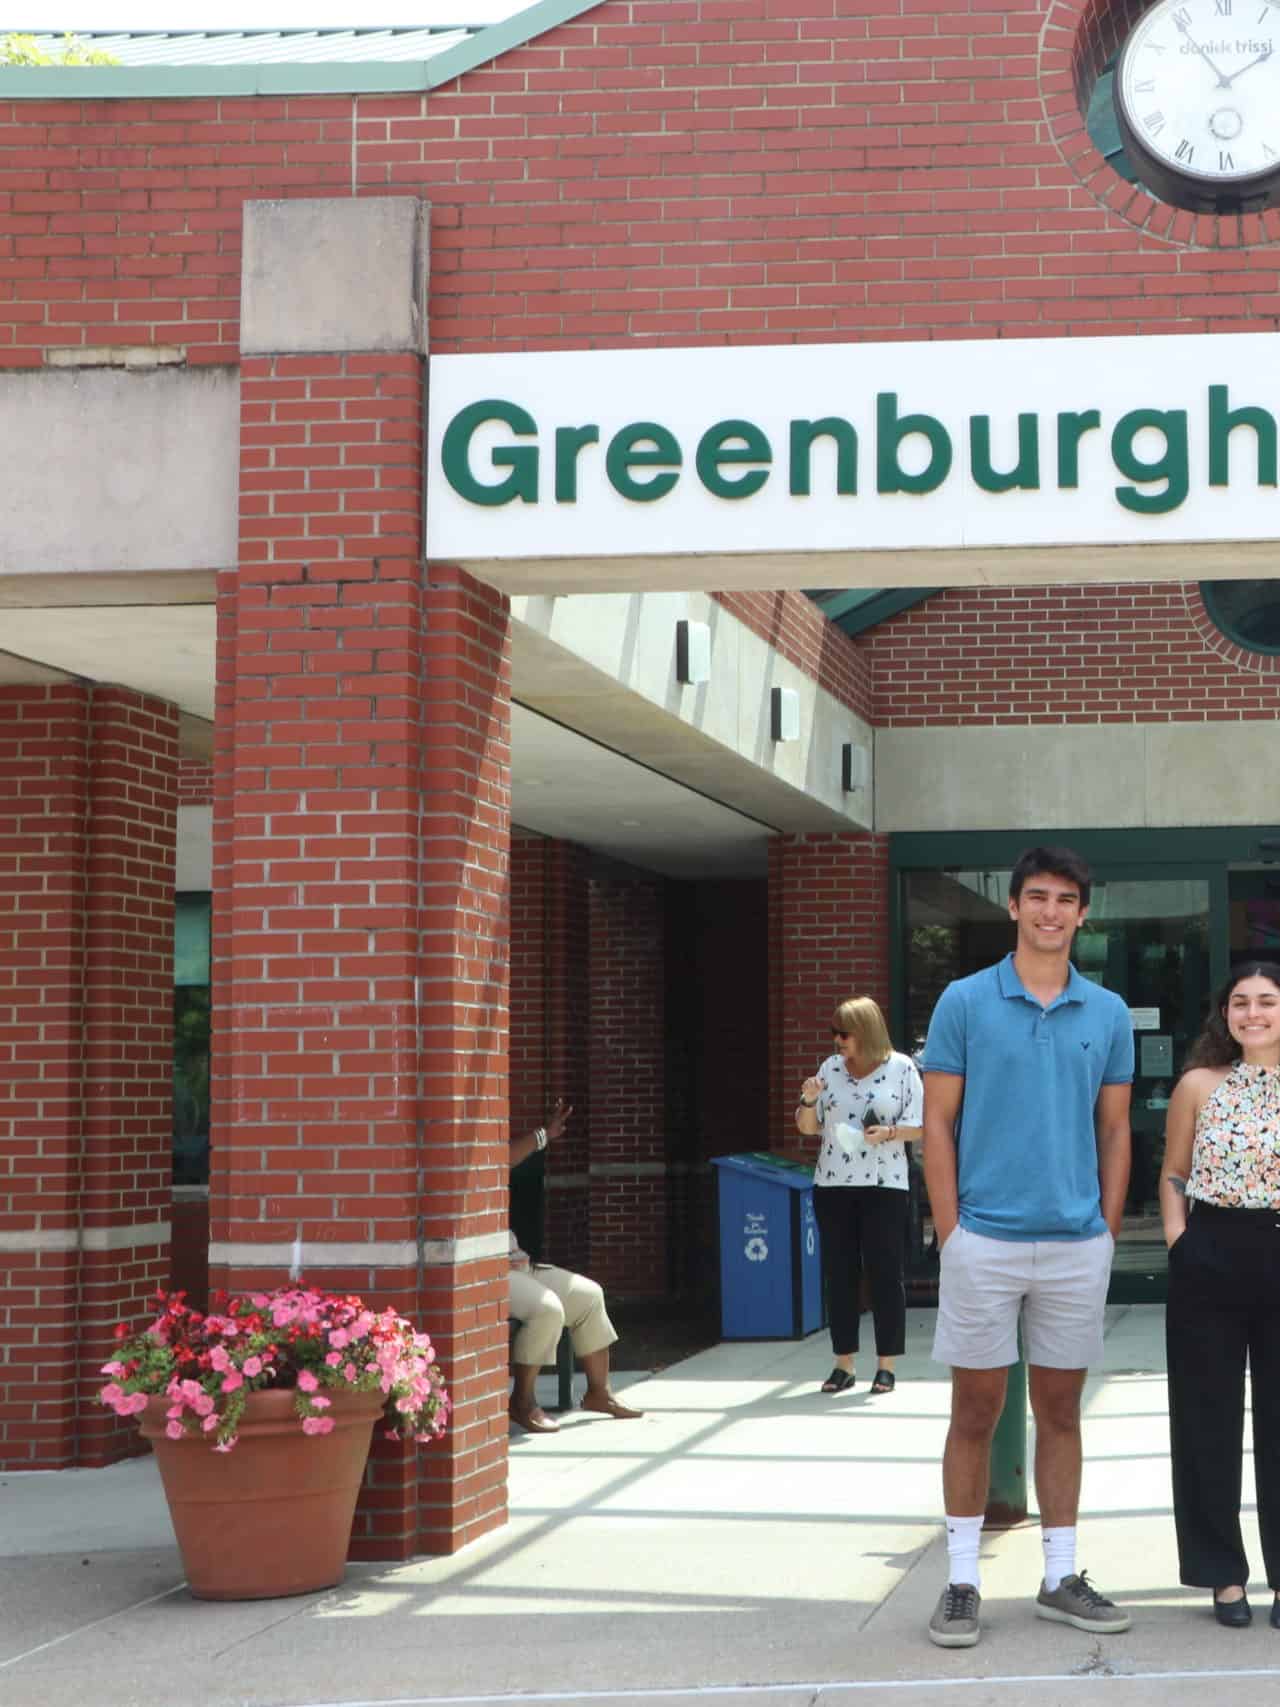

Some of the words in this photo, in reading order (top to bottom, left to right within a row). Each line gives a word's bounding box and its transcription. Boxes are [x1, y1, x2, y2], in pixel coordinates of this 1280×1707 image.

[1214, 0, 1232, 16] XII
[1218, 151, 1235, 171] VI
[441, 384, 1278, 513] Greenburgh
